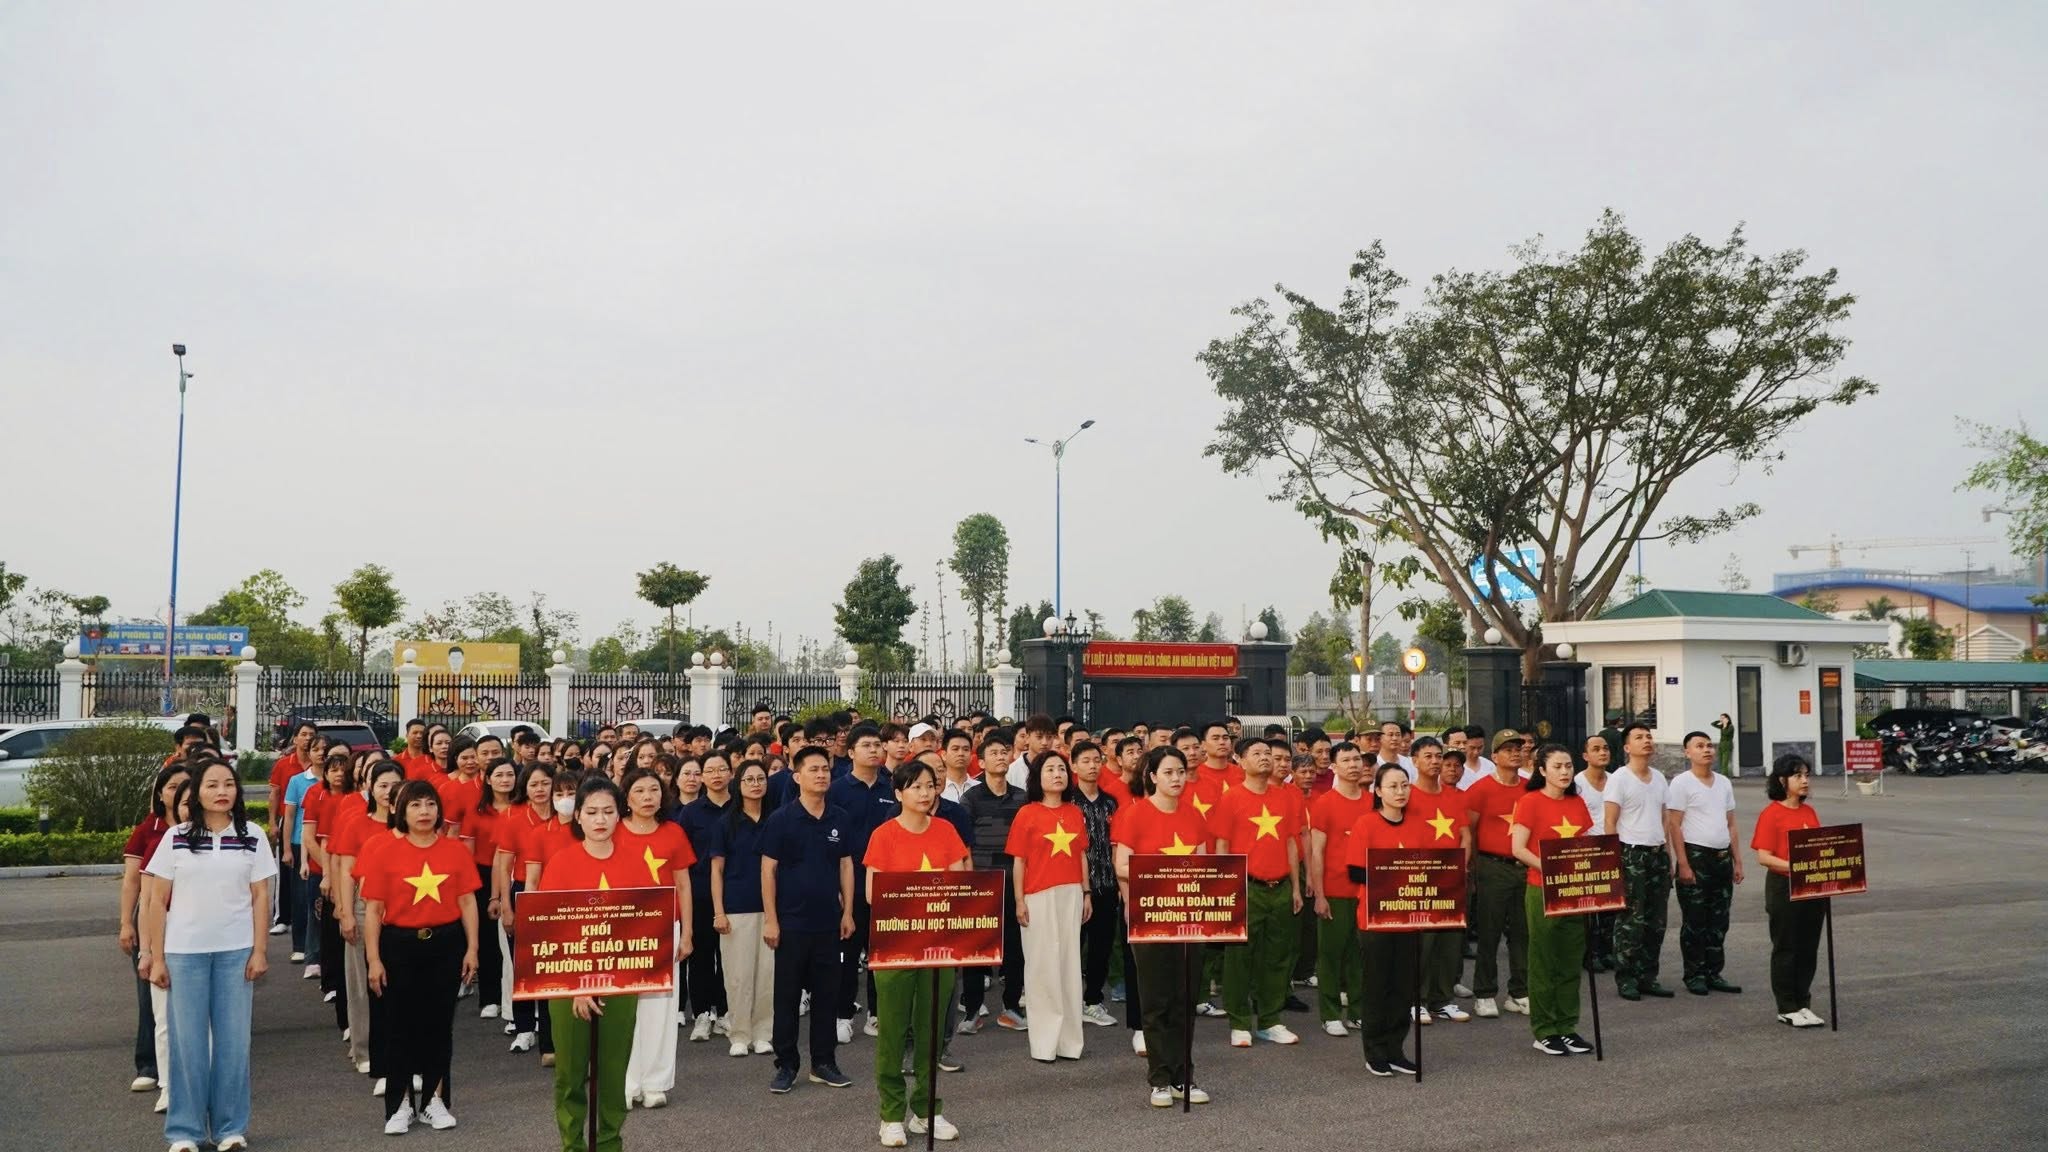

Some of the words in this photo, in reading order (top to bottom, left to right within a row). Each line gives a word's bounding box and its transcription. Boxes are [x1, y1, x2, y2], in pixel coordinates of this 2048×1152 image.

[1172, 655, 1180, 666] AN
[1408, 872, 1427, 883] KHỐI
[1177, 880, 1200, 892] KHỐI
[1398, 885, 1423, 896] CÔNG
[1425, 886, 1438, 896] AN
[926, 898, 950, 912] KHỐI
[1140, 896, 1154, 907] CƠ
[1157, 896, 1184, 908] QUAN
[1187, 894, 1214, 906] ĐOÀN
[1217, 893, 1236, 906] THỂ
[1380, 898, 1416, 911] PHƯỜNG
[1419, 898, 1431, 910] TỨ
[1432, 900, 1455, 909] MINH
[1145, 909, 1187, 922] PHƯỜNG
[1189, 909, 1203, 922] TỨ
[1205, 911, 1232, 921] MINH
[581, 921, 611, 936] KHỐI
[876, 917, 909, 931] TRƯỜNG
[911, 919, 925, 932] ĐẠI
[928, 918, 945, 932] HỌC
[947, 915, 974, 929] THÀNH
[976, 915, 998, 928] ĐÔNG
[531, 941, 558, 959] TẬP
[562, 936, 588, 954] THỂ
[591, 938, 624, 953] GIÁO
[627, 936, 658, 951] VIÊN
[536, 958, 593, 974] PHƯỜNG
[597, 956, 615, 971] TỨ
[617, 956, 654, 970] MINH
